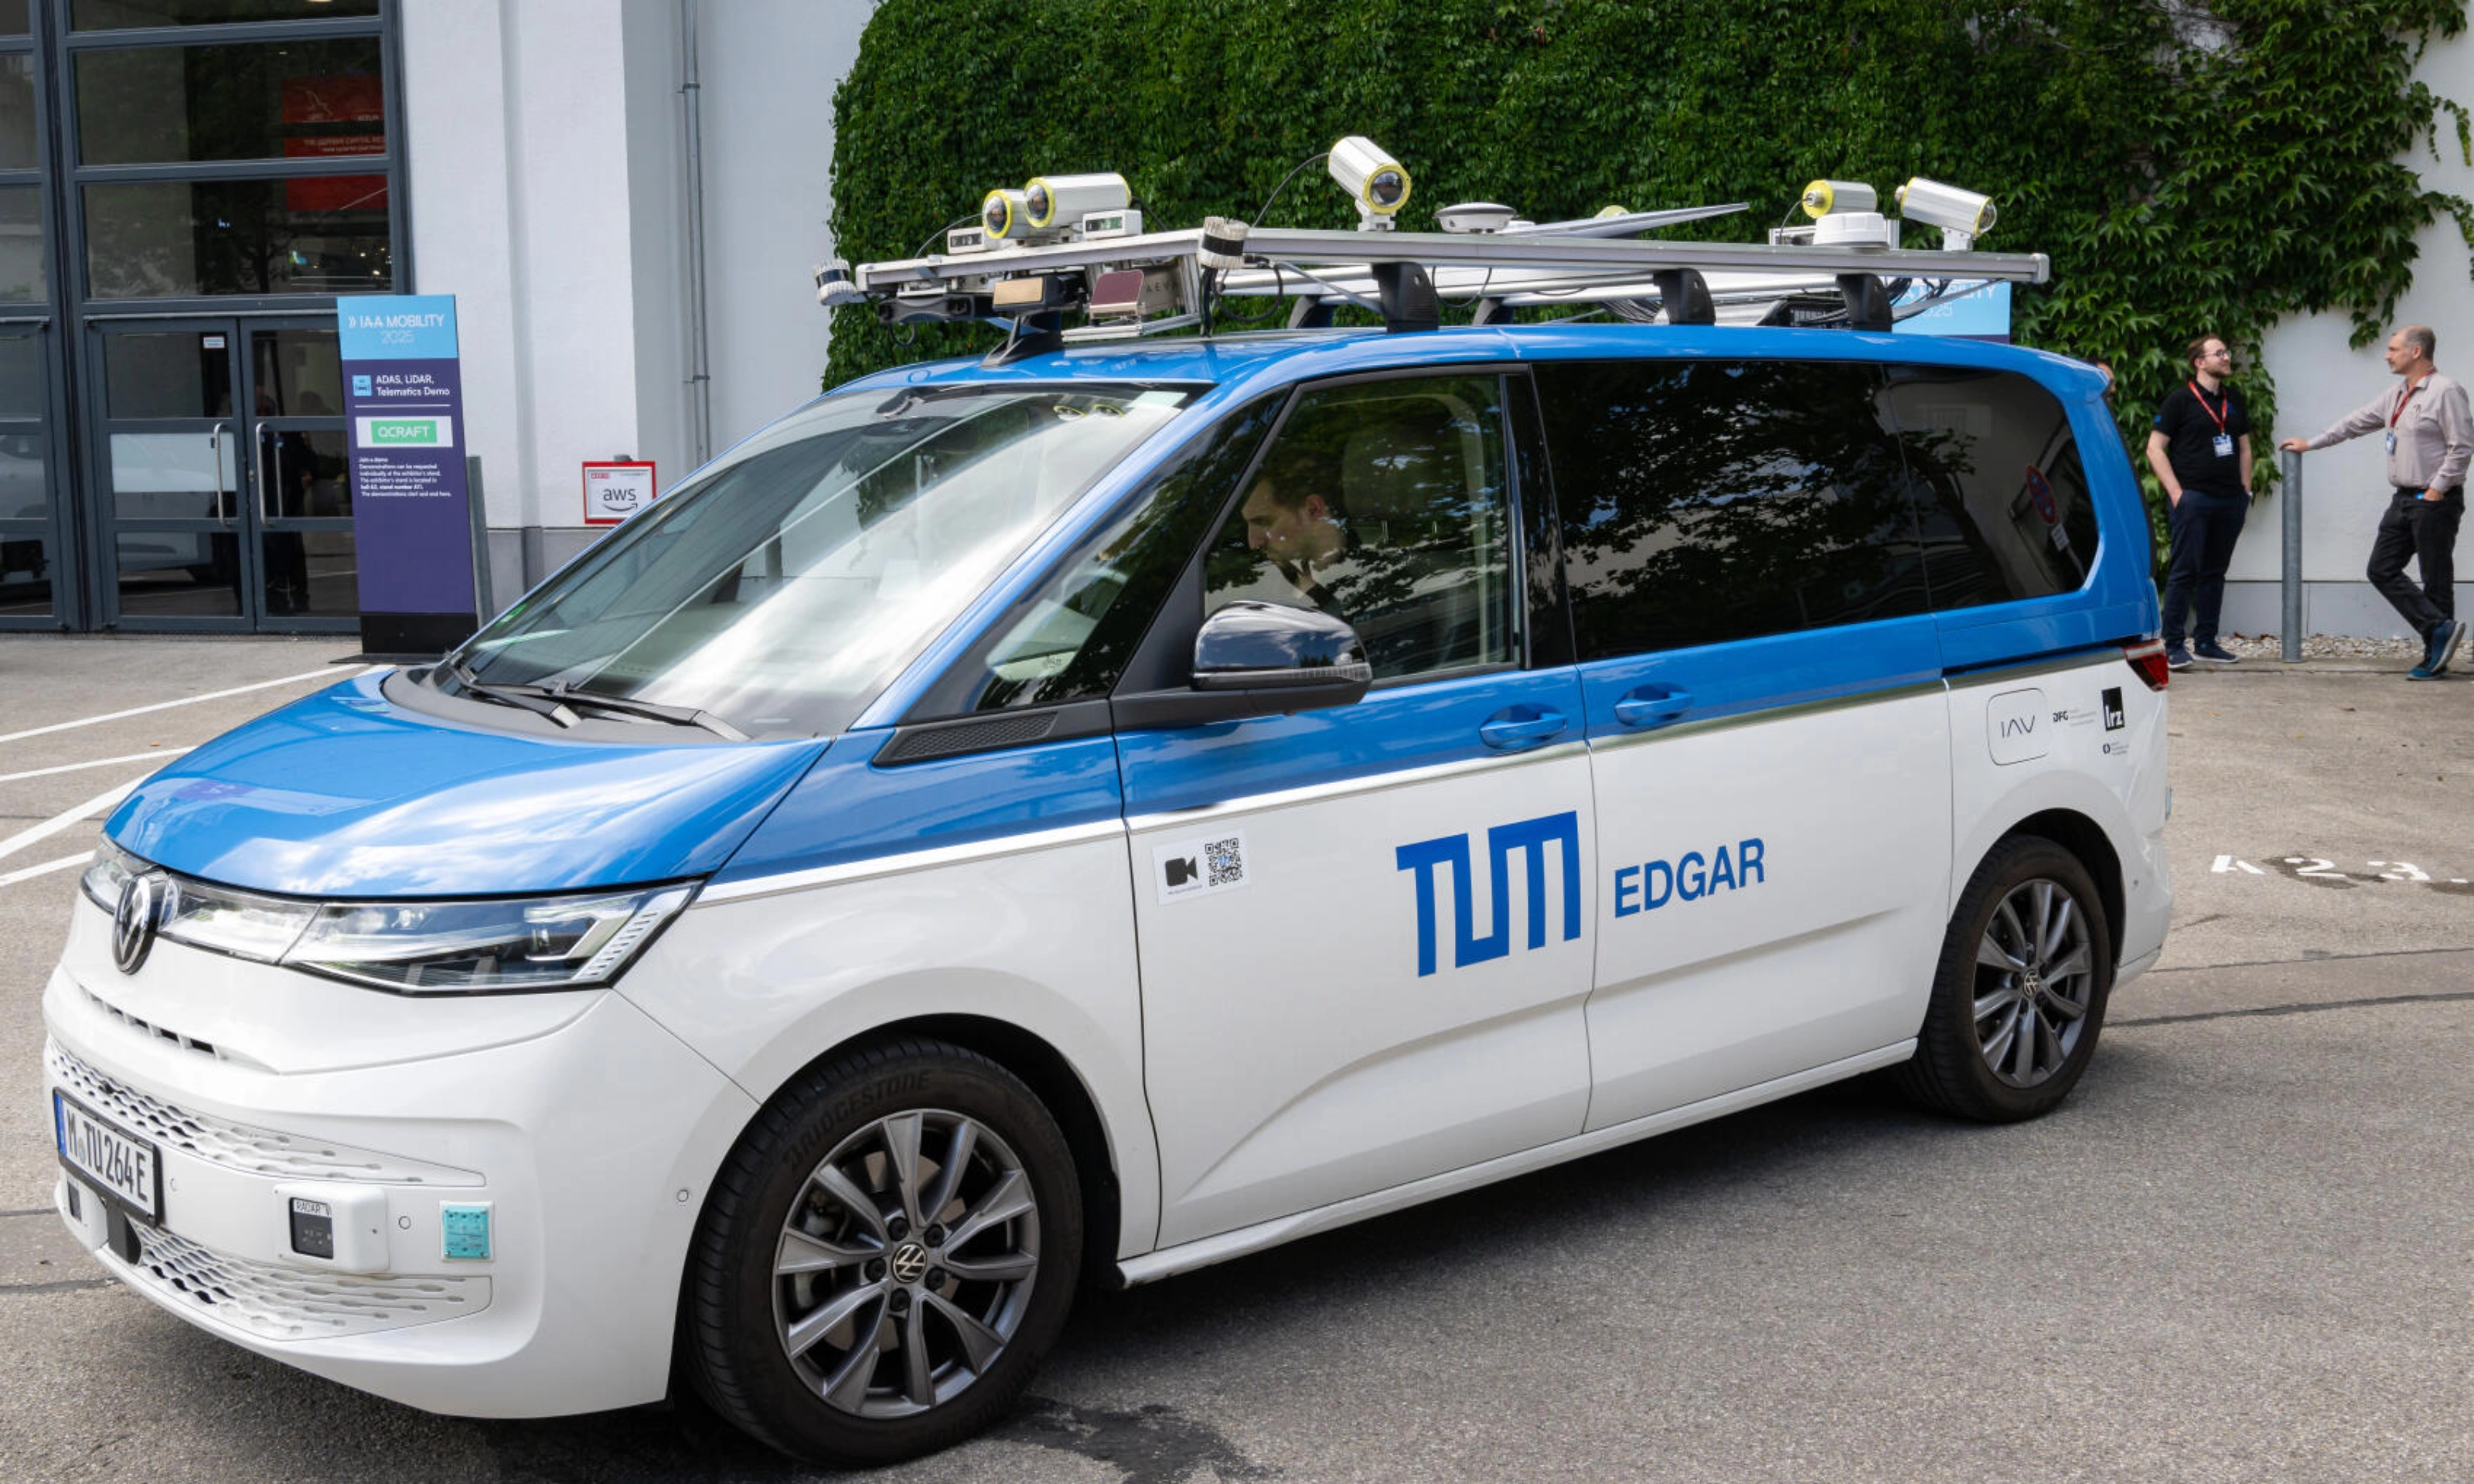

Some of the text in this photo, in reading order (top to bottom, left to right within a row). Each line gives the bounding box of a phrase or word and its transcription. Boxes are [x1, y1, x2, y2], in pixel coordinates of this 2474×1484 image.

[387, 314, 445, 327] MOBILITY
[380, 330, 414, 344] 2025
[377, 375, 403, 385] ADAS,
[377, 386, 451, 397] Telematics Demo
[377, 426, 430, 438] QCRAFT
[603, 488, 636, 501] aws
[1395, 811, 1764, 977] TUM EDGAR
[66, 1108, 148, 1203] M TU 264E
